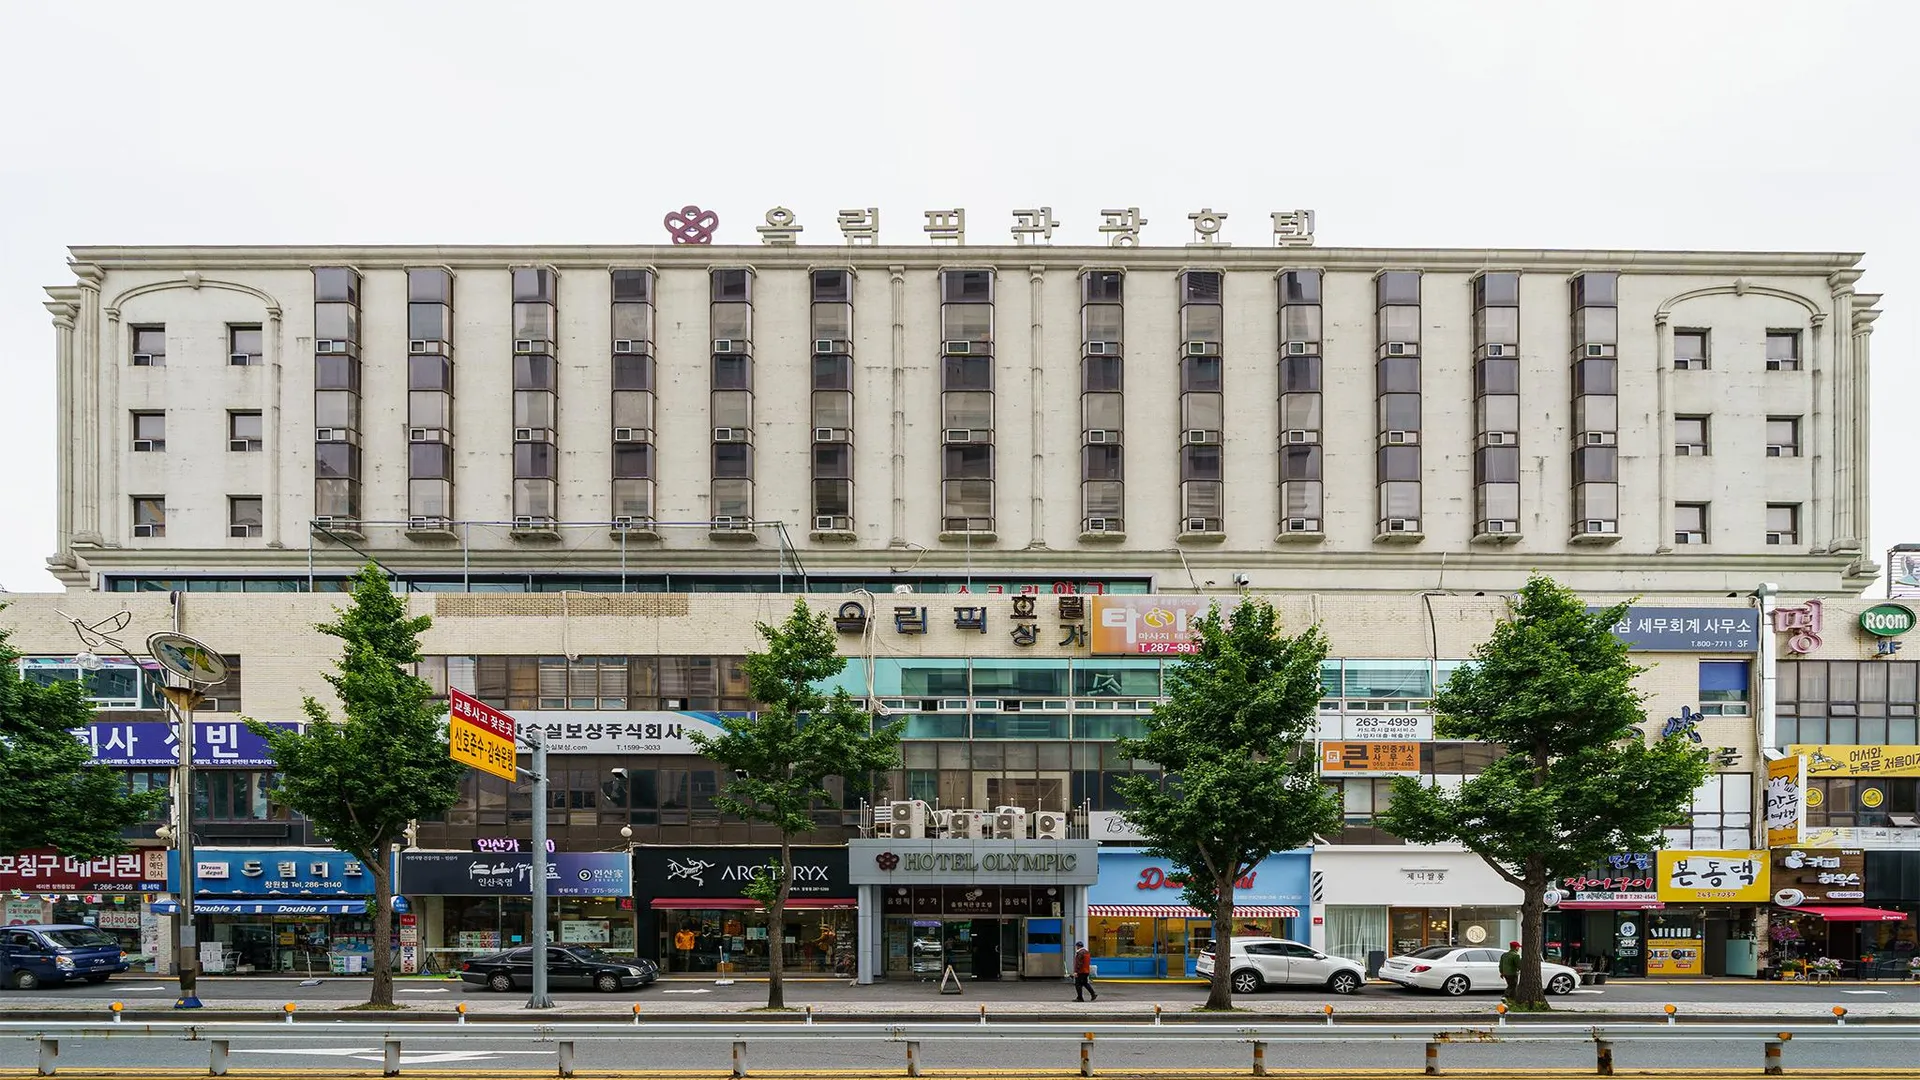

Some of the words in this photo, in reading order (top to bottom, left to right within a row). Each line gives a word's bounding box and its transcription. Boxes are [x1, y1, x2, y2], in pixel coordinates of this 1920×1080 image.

[1637, 618, 1700, 634] 세무회계
[1704, 618, 1752, 634] 사무소
[1865, 611, 1908, 630] Room
[1010, 623, 1088, 648] 상가
[1139, 632, 1170, 640] 마사지
[1737, 639, 1749, 648] 3F
[454, 698, 488, 724] 교통사고
[491, 715, 513, 737] 잦은곳
[1356, 717, 1418, 727] 263-4999
[1342, 744, 1369, 769] 큰
[1373, 744, 1414, 754] 공인중개사
[1849, 760, 1881, 775] 뉴욕은
[1768, 793, 1798, 809] 만두
[1770, 809, 1796, 820] 여행
[477, 838, 520, 852] 인산가
[0, 854, 60, 878] 모침구
[904, 852, 979, 872] HOTEL
[982, 852, 1077, 872] OLYMPIC
[721, 864, 829, 881] ARC'TRYX
[1671, 859, 1754, 888] 본동댁
[194, 905, 230, 913] Double
[277, 905, 317, 913] Double
